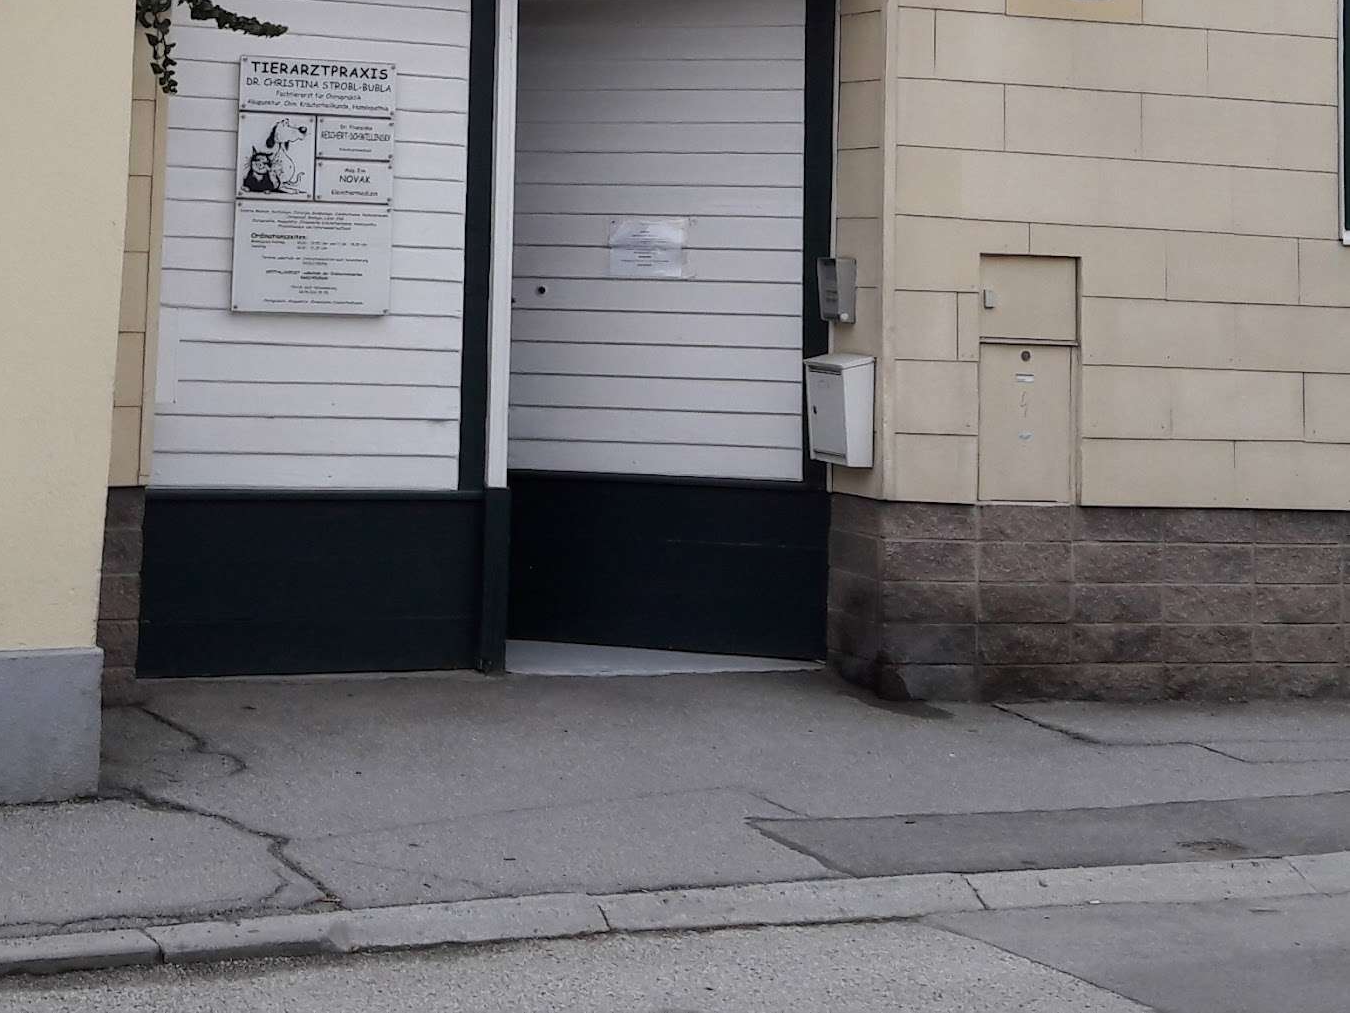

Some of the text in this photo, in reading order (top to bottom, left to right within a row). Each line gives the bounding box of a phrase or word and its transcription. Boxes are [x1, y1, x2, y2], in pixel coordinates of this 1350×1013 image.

[251, 61, 388, 80] TIERARZTPRAXIS
[263, 78, 319, 89] CHRISTINA
[339, 175, 371, 184] NOVAK
